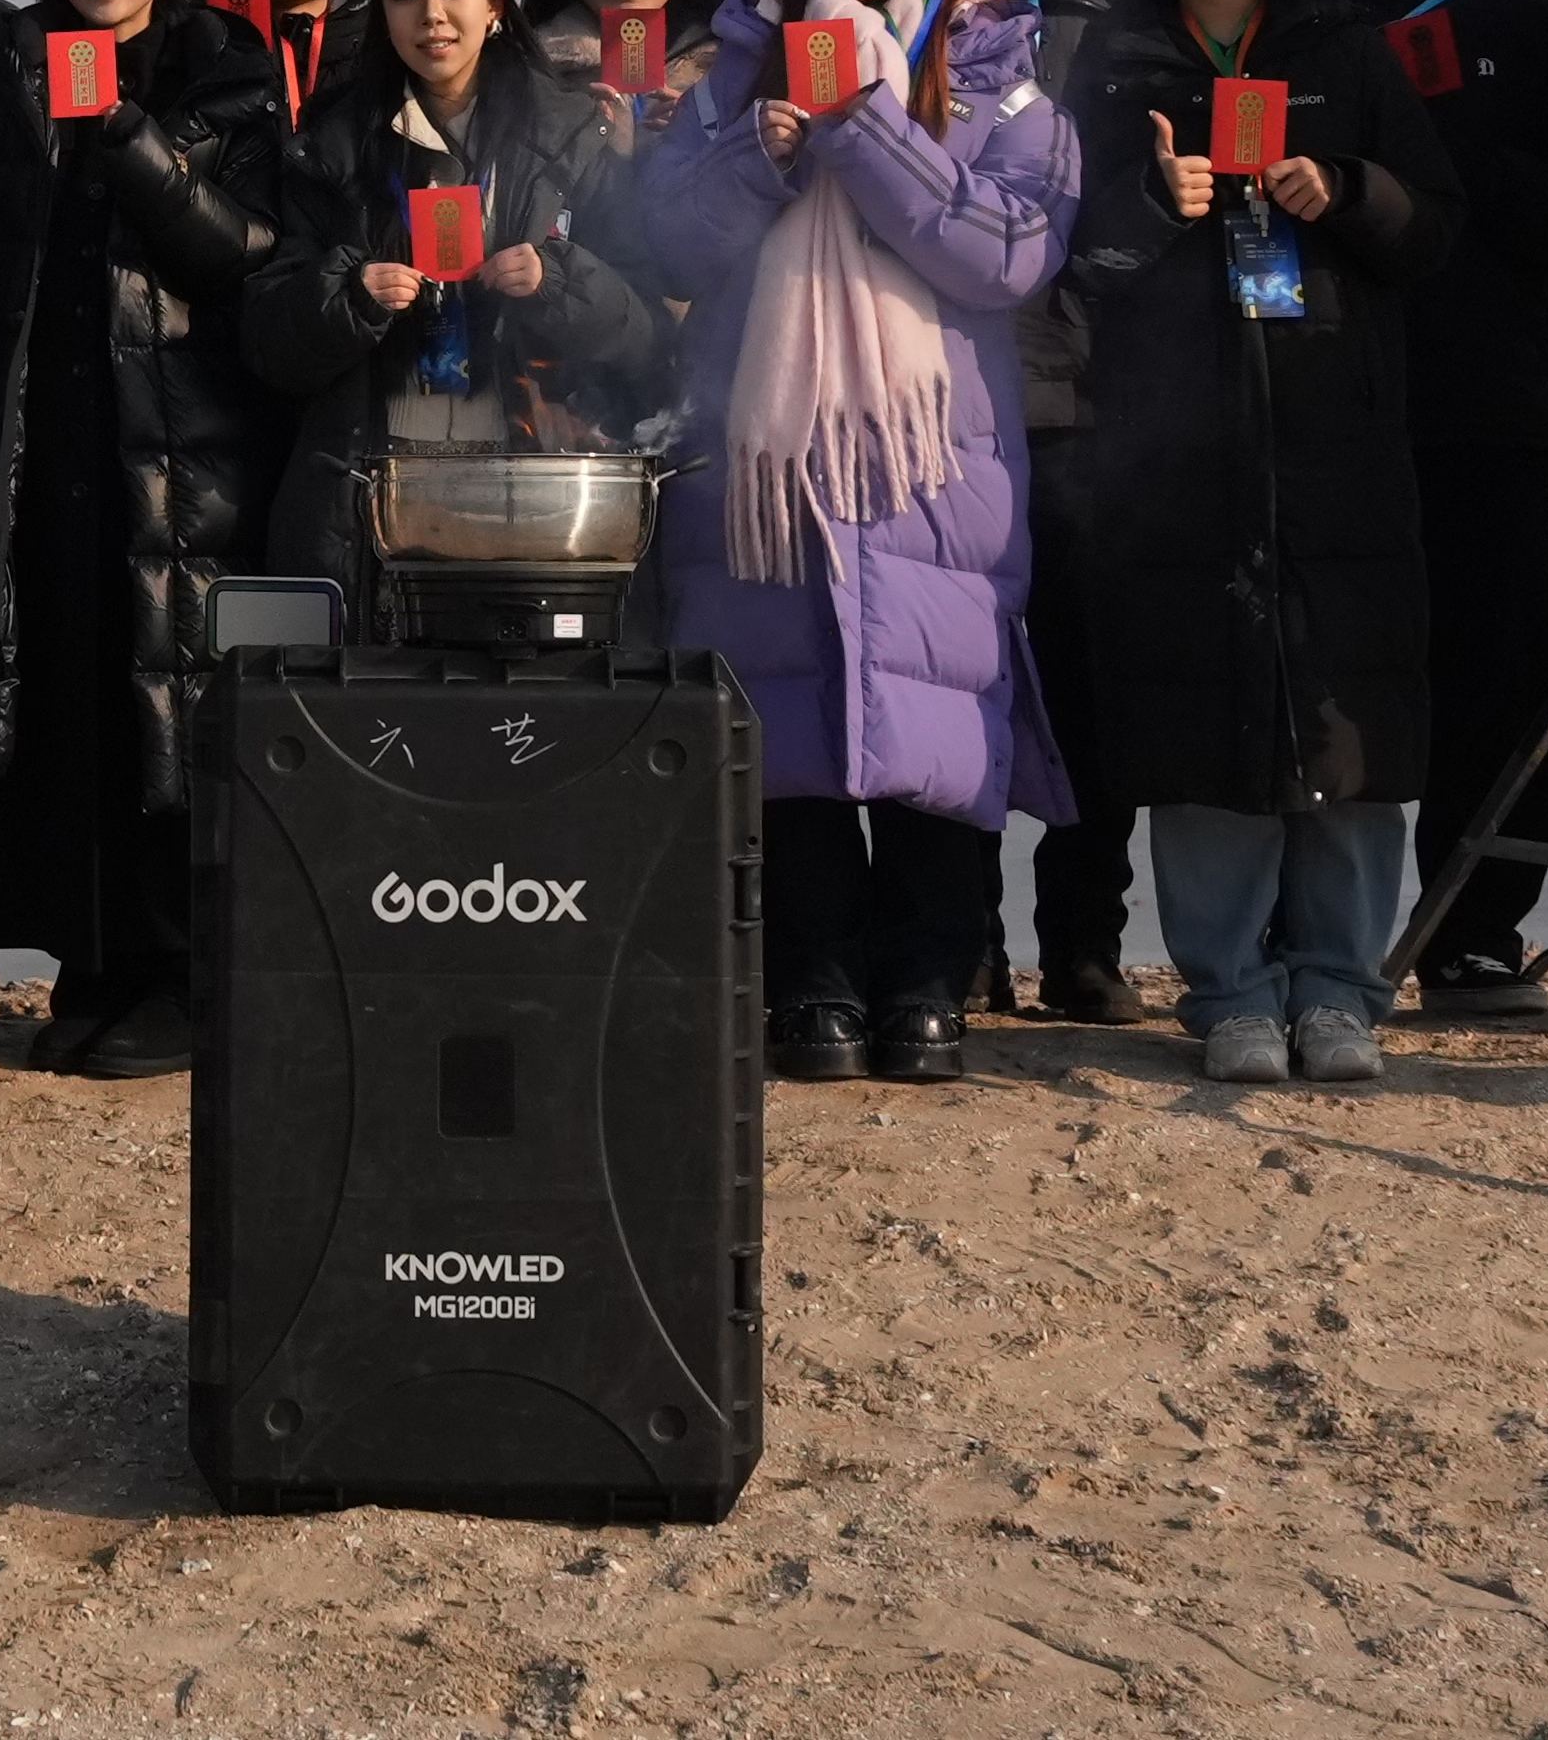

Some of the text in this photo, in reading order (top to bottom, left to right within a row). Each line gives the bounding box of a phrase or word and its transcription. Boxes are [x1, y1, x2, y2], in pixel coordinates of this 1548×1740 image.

[1285, 95, 1325, 107] assion
[371, 862, 588, 923] Godox
[385, 1251, 565, 1285] KNOWLED
[414, 1295, 536, 1319] MG1200Bi
